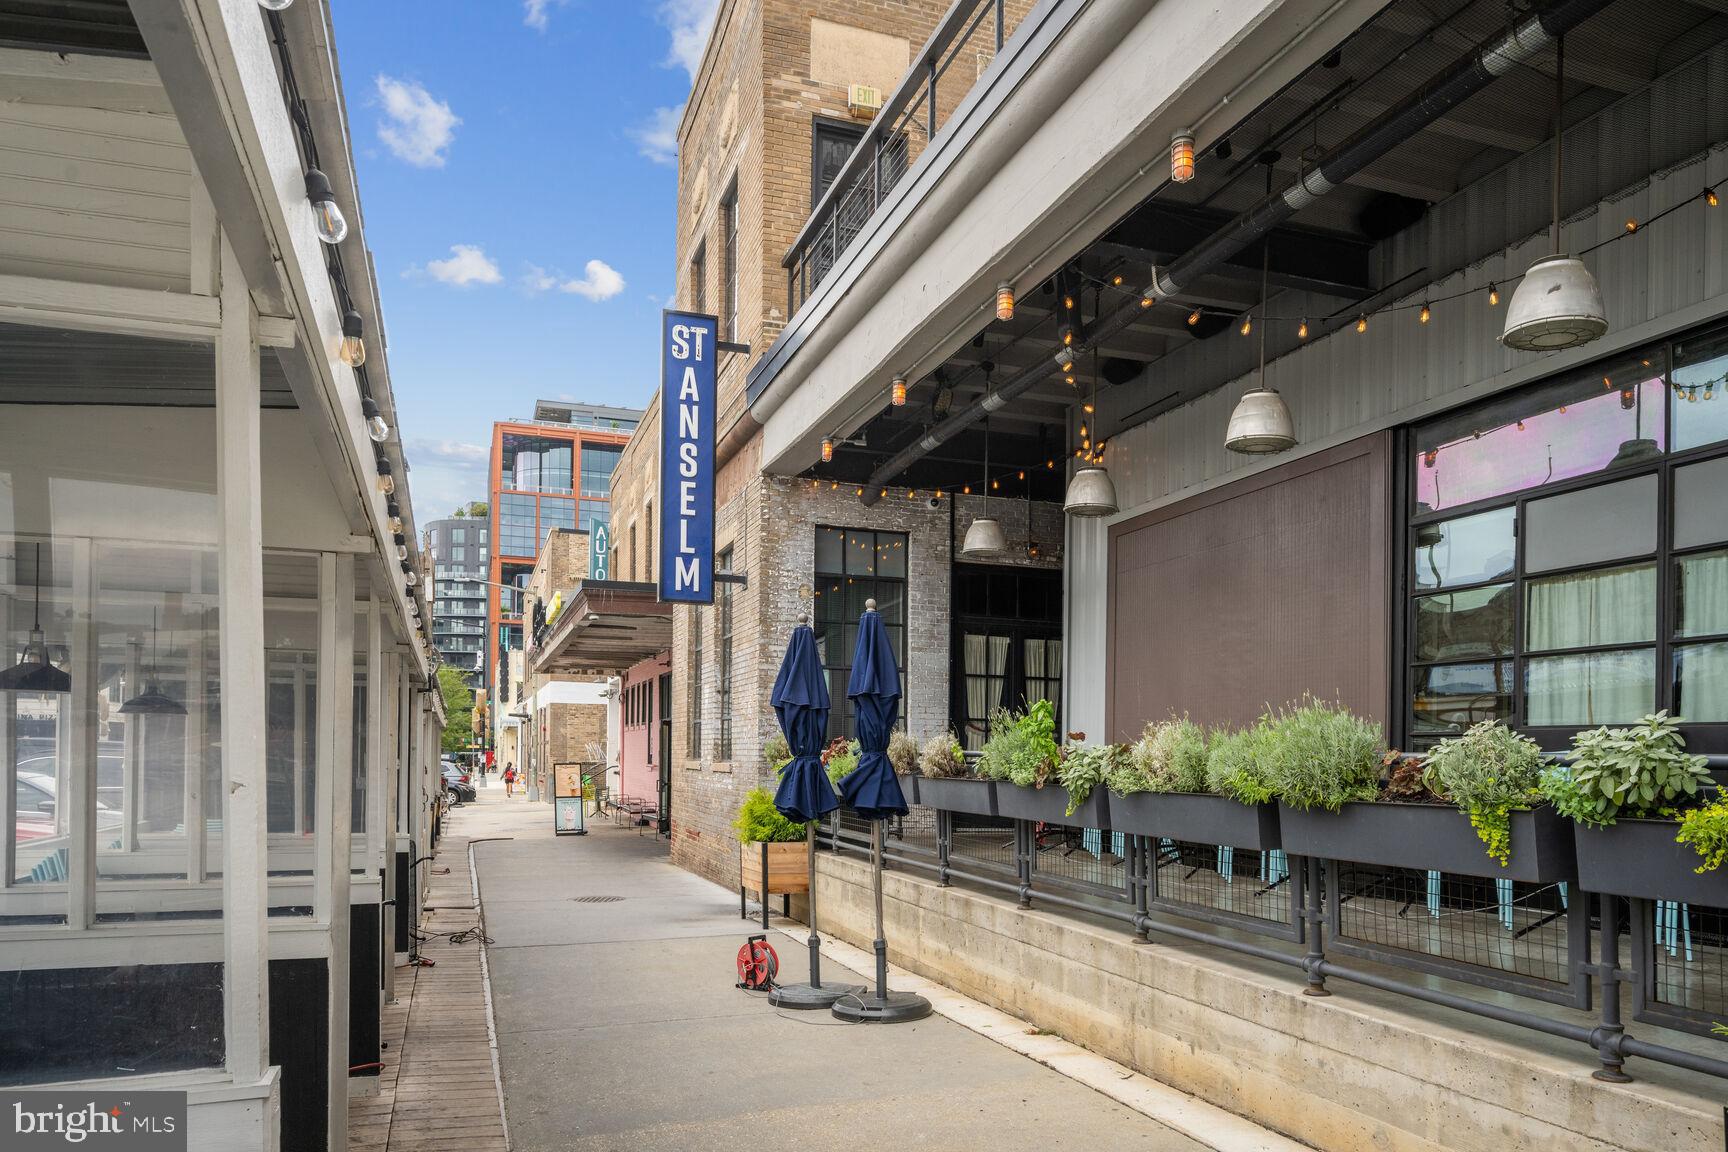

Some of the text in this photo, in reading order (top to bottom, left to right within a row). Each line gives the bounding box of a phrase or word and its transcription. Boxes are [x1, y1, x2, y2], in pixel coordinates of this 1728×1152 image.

[857, 87, 875, 105] EXIT
[671, 324, 708, 361] ST
[674, 366, 700, 592] ANSELM
[595, 526, 607, 580] AUTO
